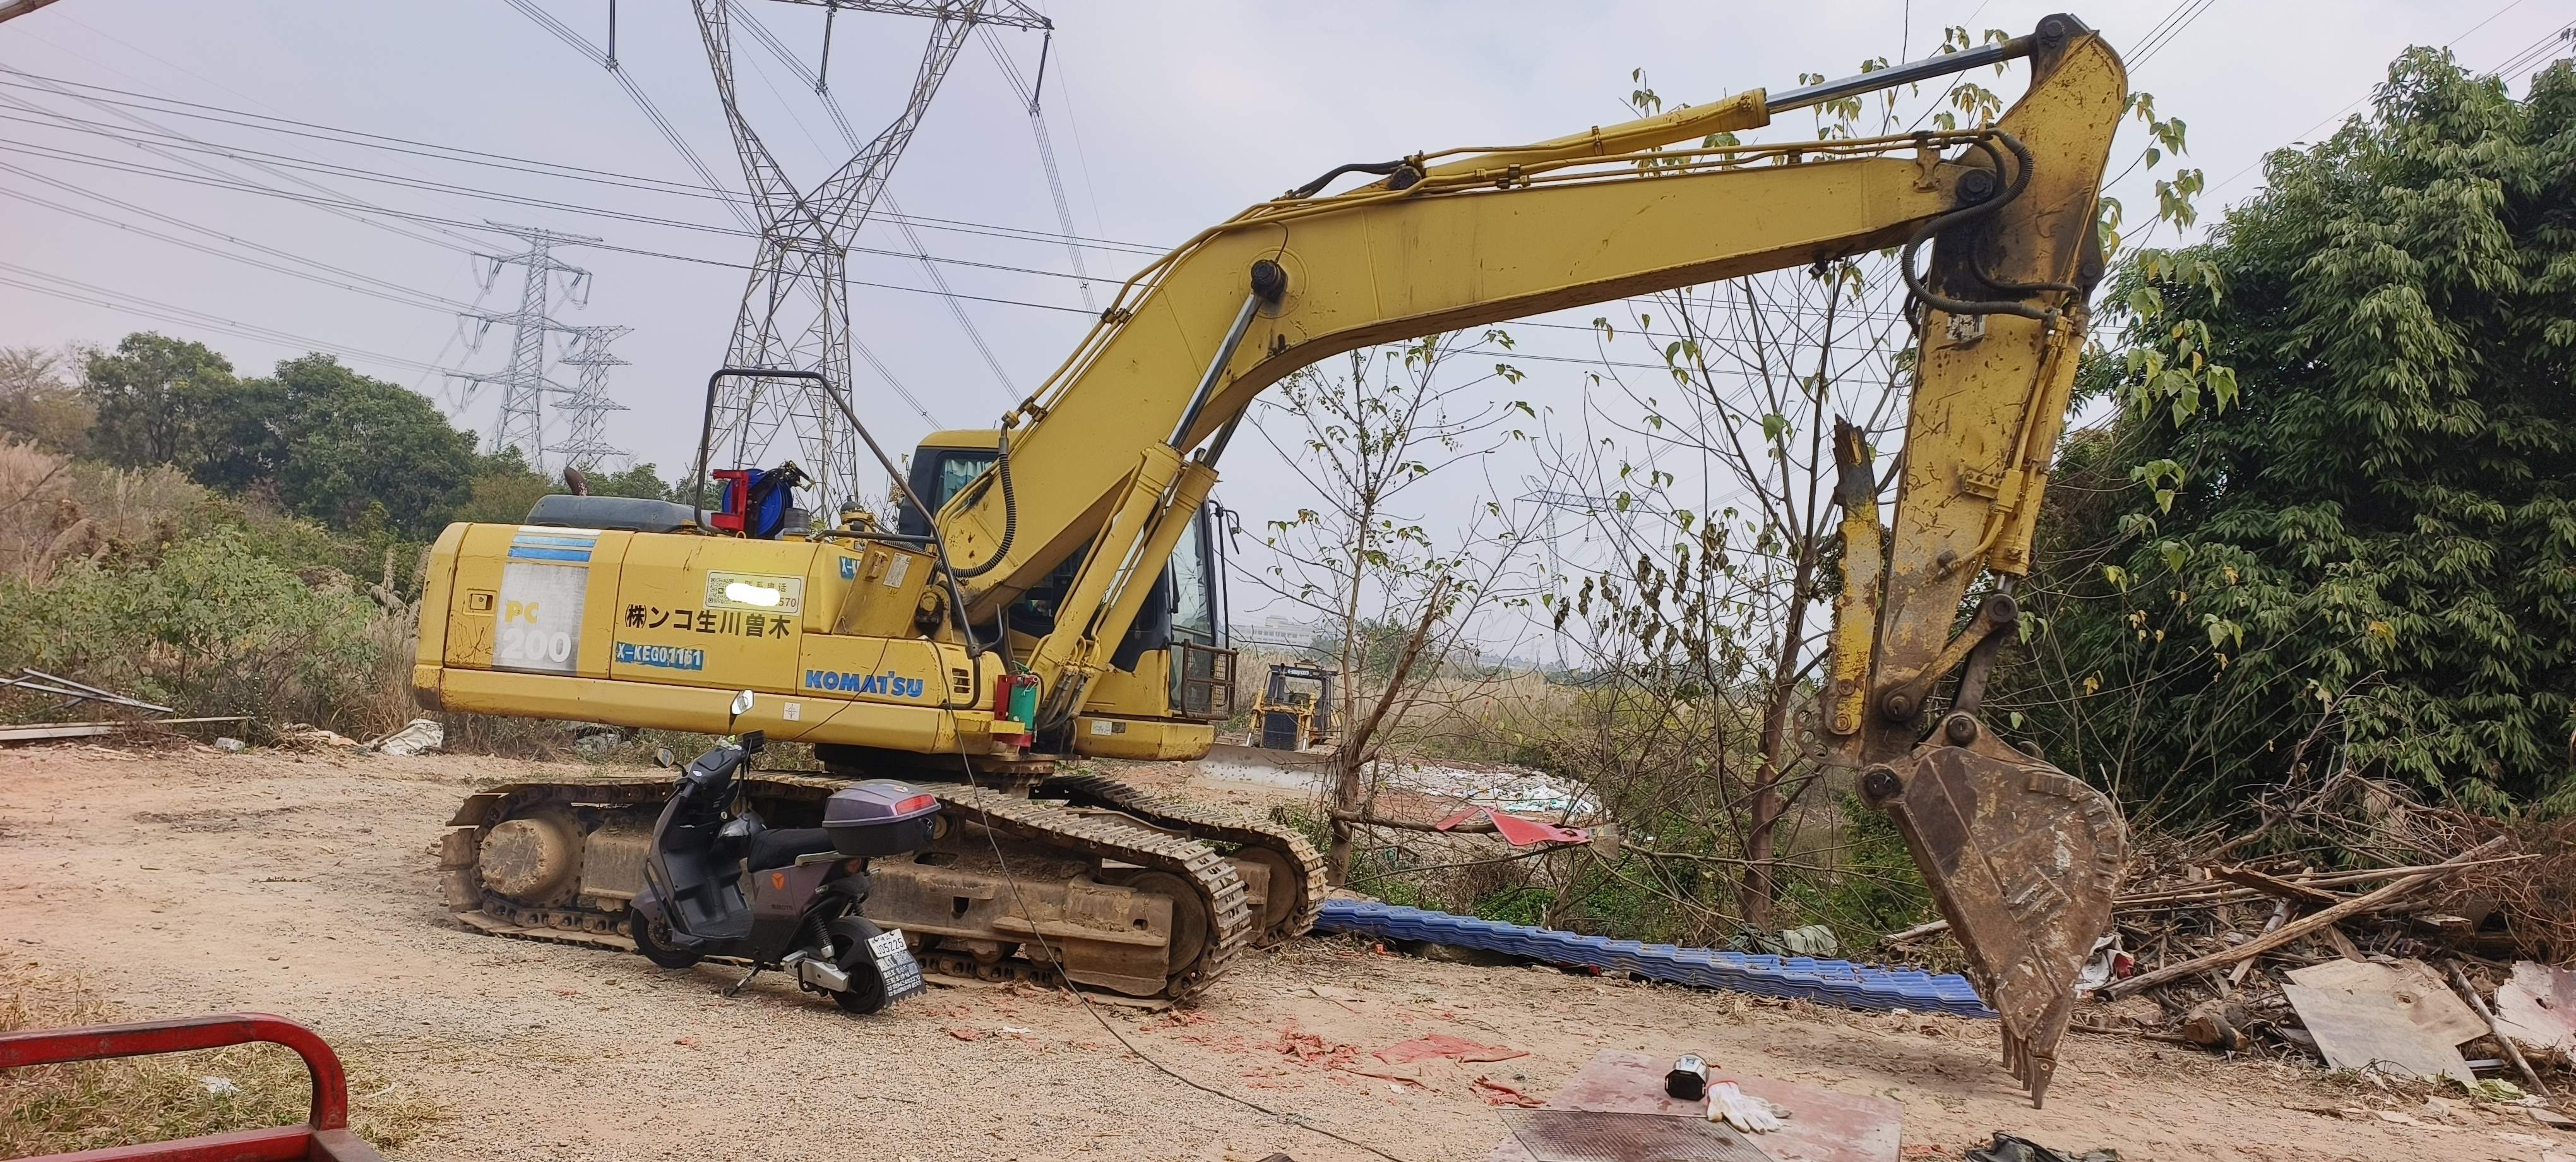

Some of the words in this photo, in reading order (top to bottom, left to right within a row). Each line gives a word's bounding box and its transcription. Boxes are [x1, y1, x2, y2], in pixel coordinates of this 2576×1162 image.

[505, 600, 539, 624] PC
[501, 628, 571, 662] 200
[806, 669, 923, 697] KOMATSU
